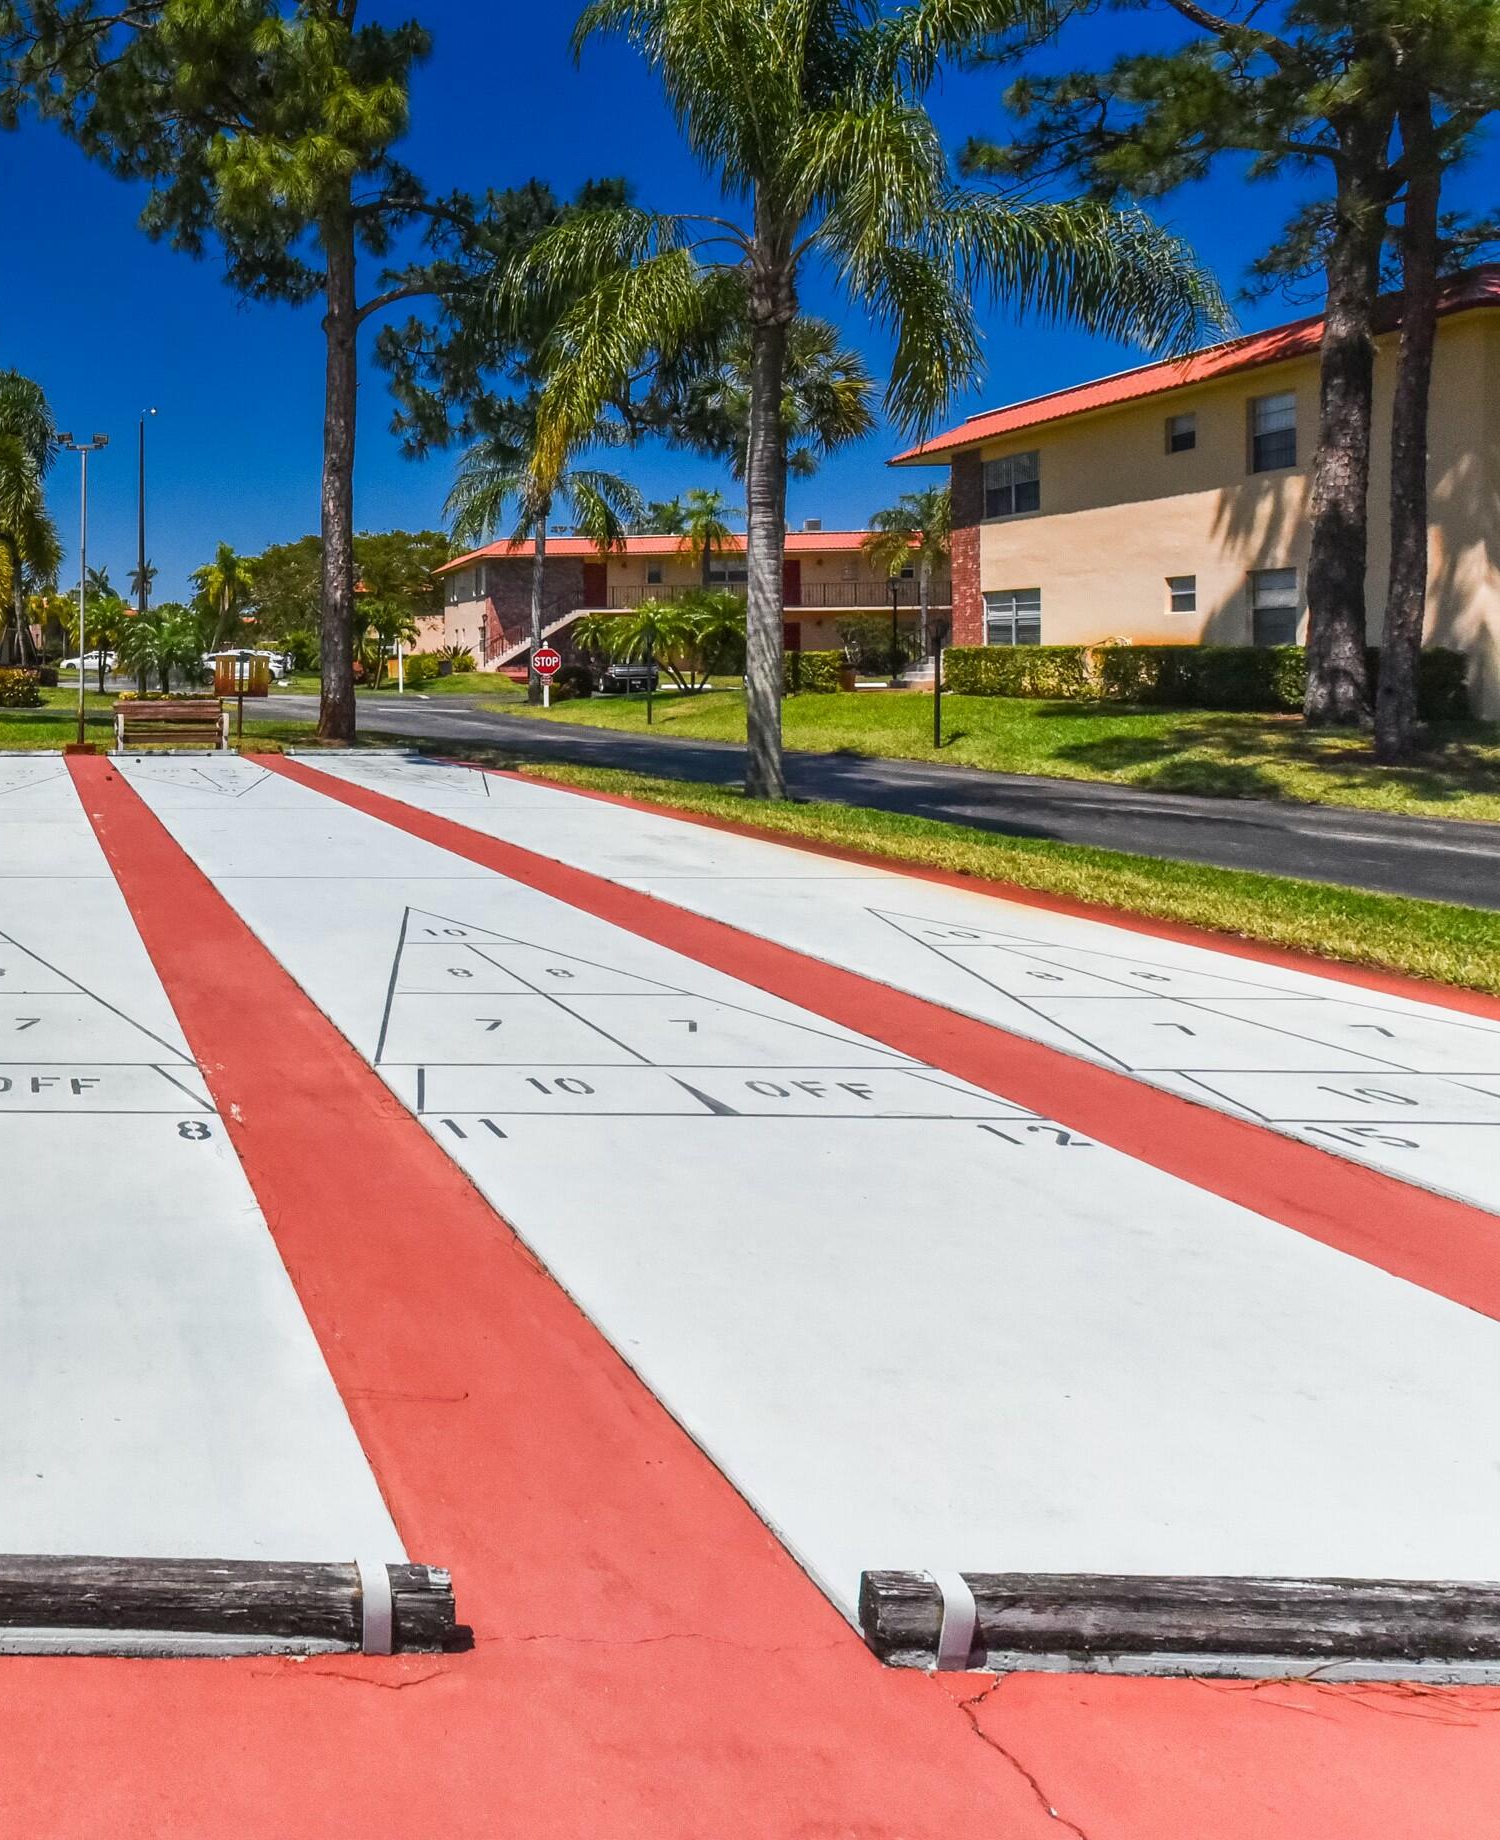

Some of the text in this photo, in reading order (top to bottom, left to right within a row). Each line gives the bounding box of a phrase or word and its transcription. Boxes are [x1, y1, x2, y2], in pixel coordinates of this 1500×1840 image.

[534, 656, 559, 667] STOP
[423, 929, 468, 937] 10
[923, 930, 980, 939] 10
[447, 968, 473, 977] 8
[546, 969, 574, 978] 8
[1026, 971, 1063, 981] 8
[1130, 971, 1171, 981] 8
[15, 1018, 41, 1030] 7
[476, 1019, 502, 1031] 7
[669, 1020, 697, 1032] 7
[1153, 1023, 1196, 1036] 7
[1349, 1025, 1395, 1037] 7
[526, 1078, 873, 1100] 10 OFF
[1317, 1086, 1419, 1105] 10
[177, 1121, 211, 1140] 8
[439, 1119, 509, 1139] 11
[975, 1124, 1096, 1147] 12
[1303, 1126, 1420, 1148] 15
